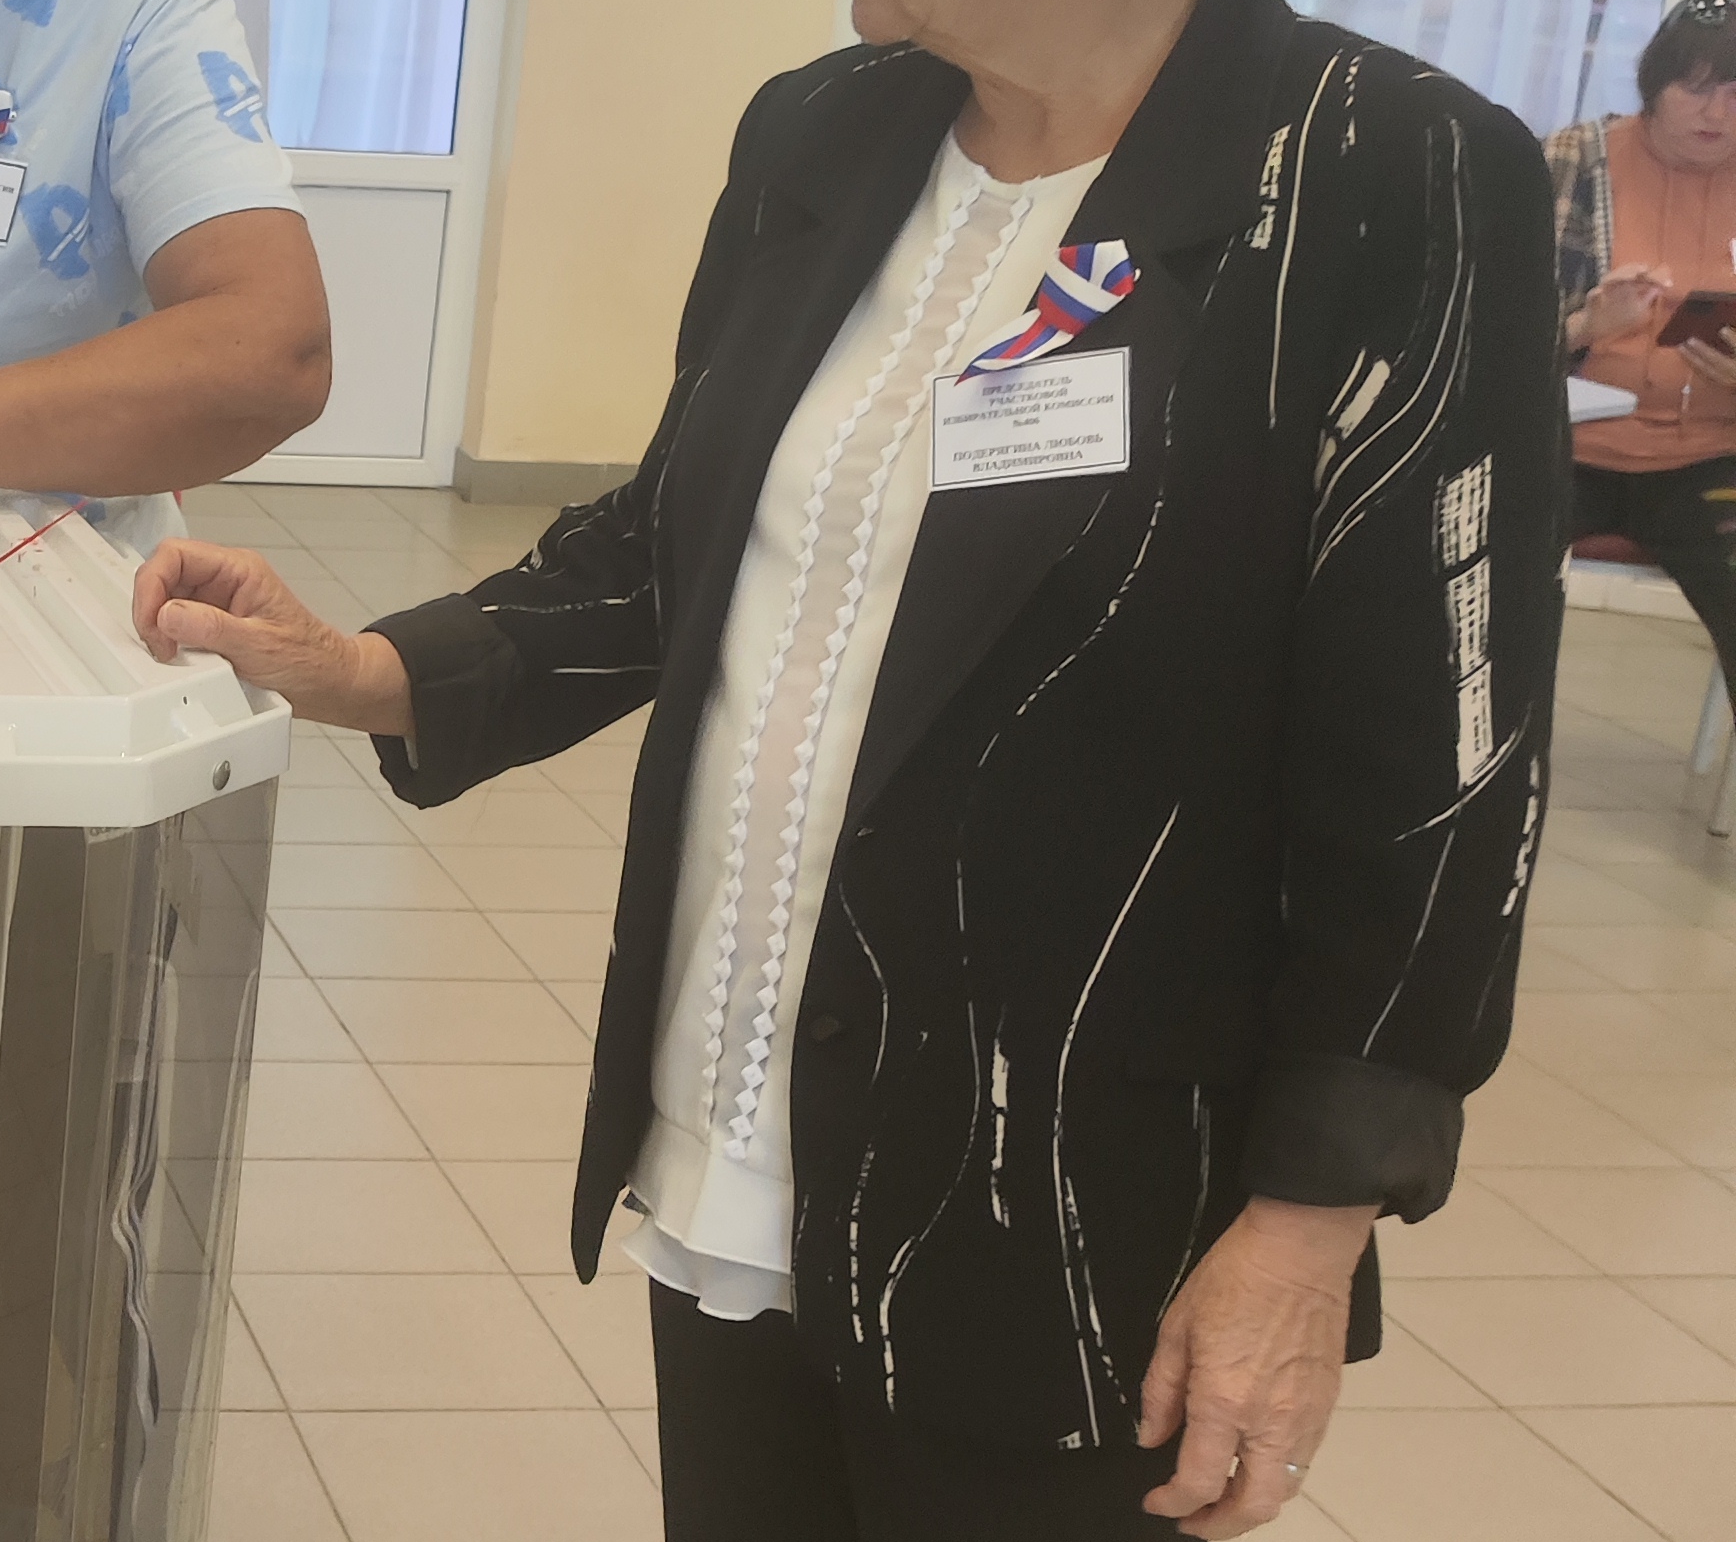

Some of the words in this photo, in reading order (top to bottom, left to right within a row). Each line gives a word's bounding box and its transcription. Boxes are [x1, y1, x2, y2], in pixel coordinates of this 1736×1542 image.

[989, 388, 1068, 408] УЧАСТКОВОЙ
[942, 403, 1041, 426] ИЗБИРАТЕЛЬНОЙ
[1044, 394, 1114, 412] КОМИССИИ
[1044, 432, 1104, 450] ЛЮБОВЬ
[972, 450, 1084, 473] ВЛАДИМИРОВНА
